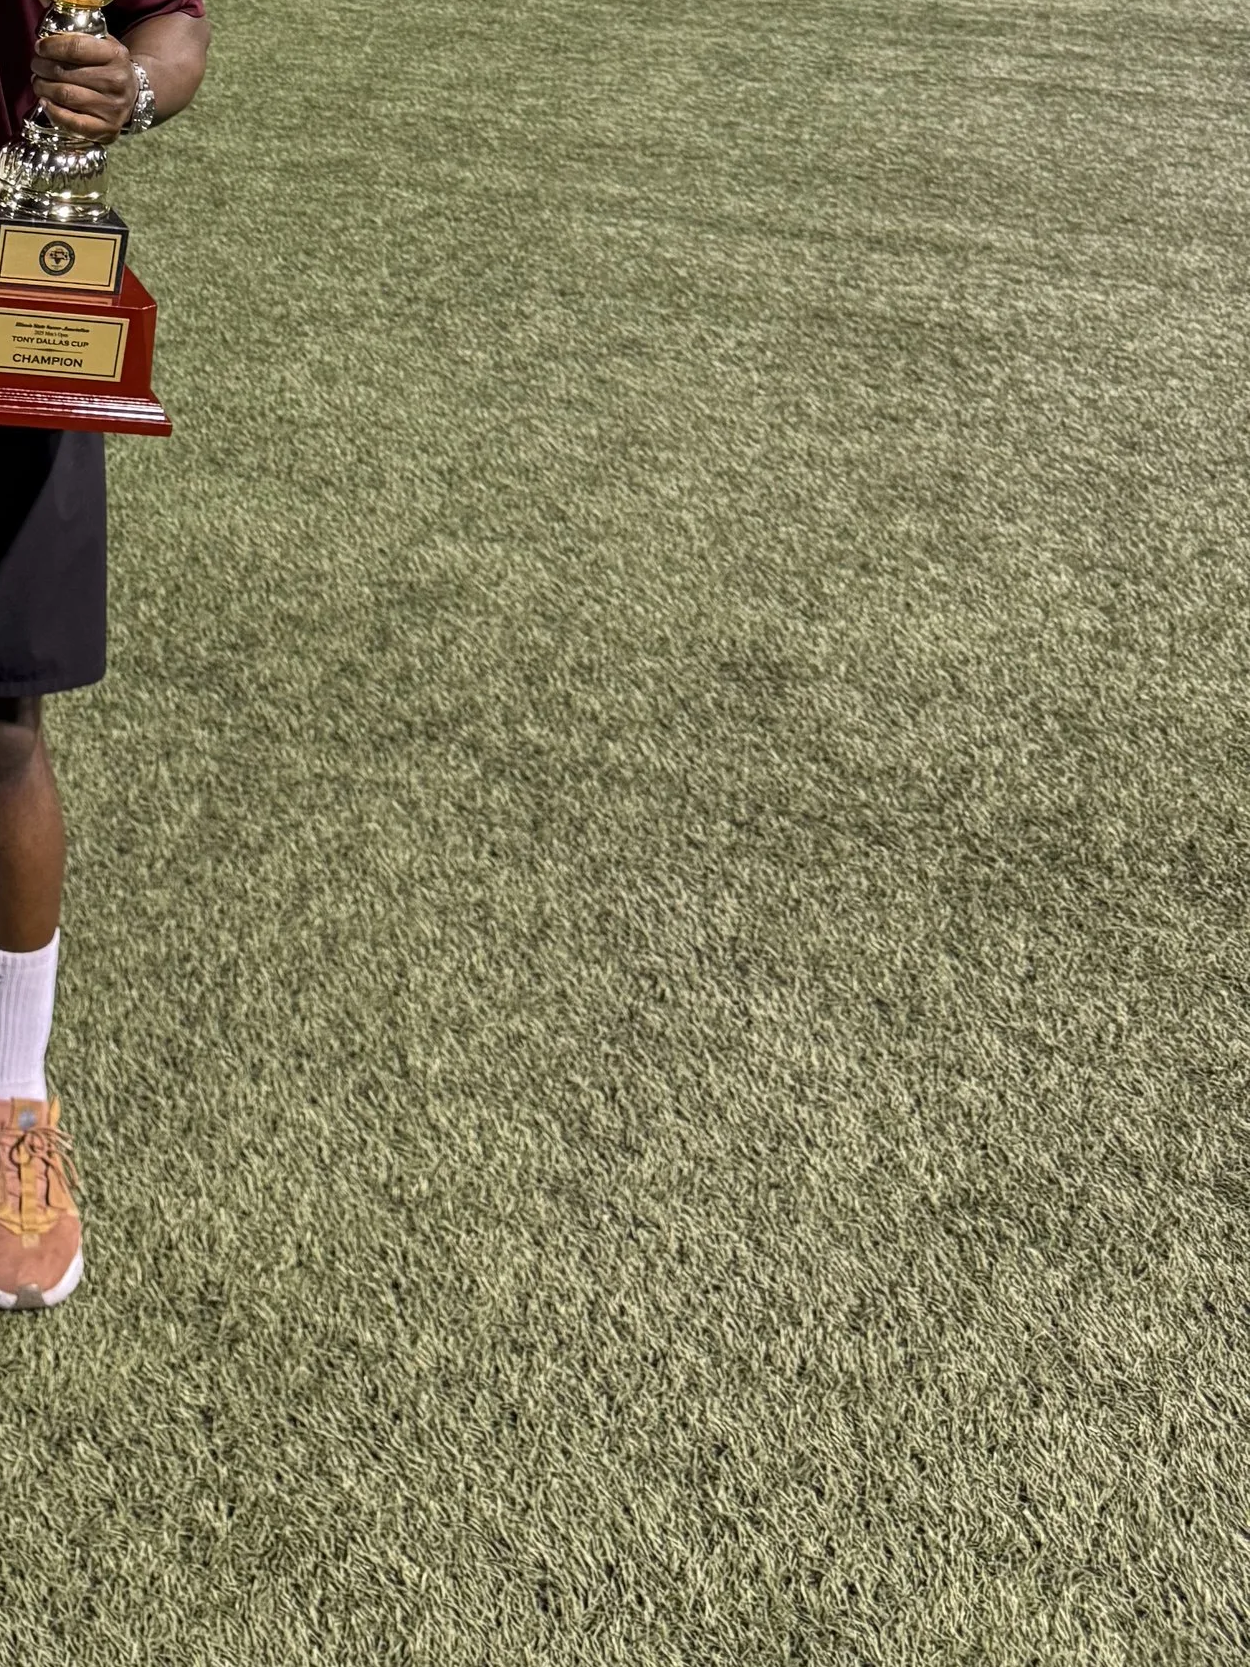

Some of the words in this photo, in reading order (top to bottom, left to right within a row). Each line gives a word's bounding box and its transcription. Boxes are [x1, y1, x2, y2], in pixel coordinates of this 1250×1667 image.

[12, 335, 34, 343] TONY
[36, 338, 69, 346] DALLAS
[12, 353, 83, 368] CHAMPION
